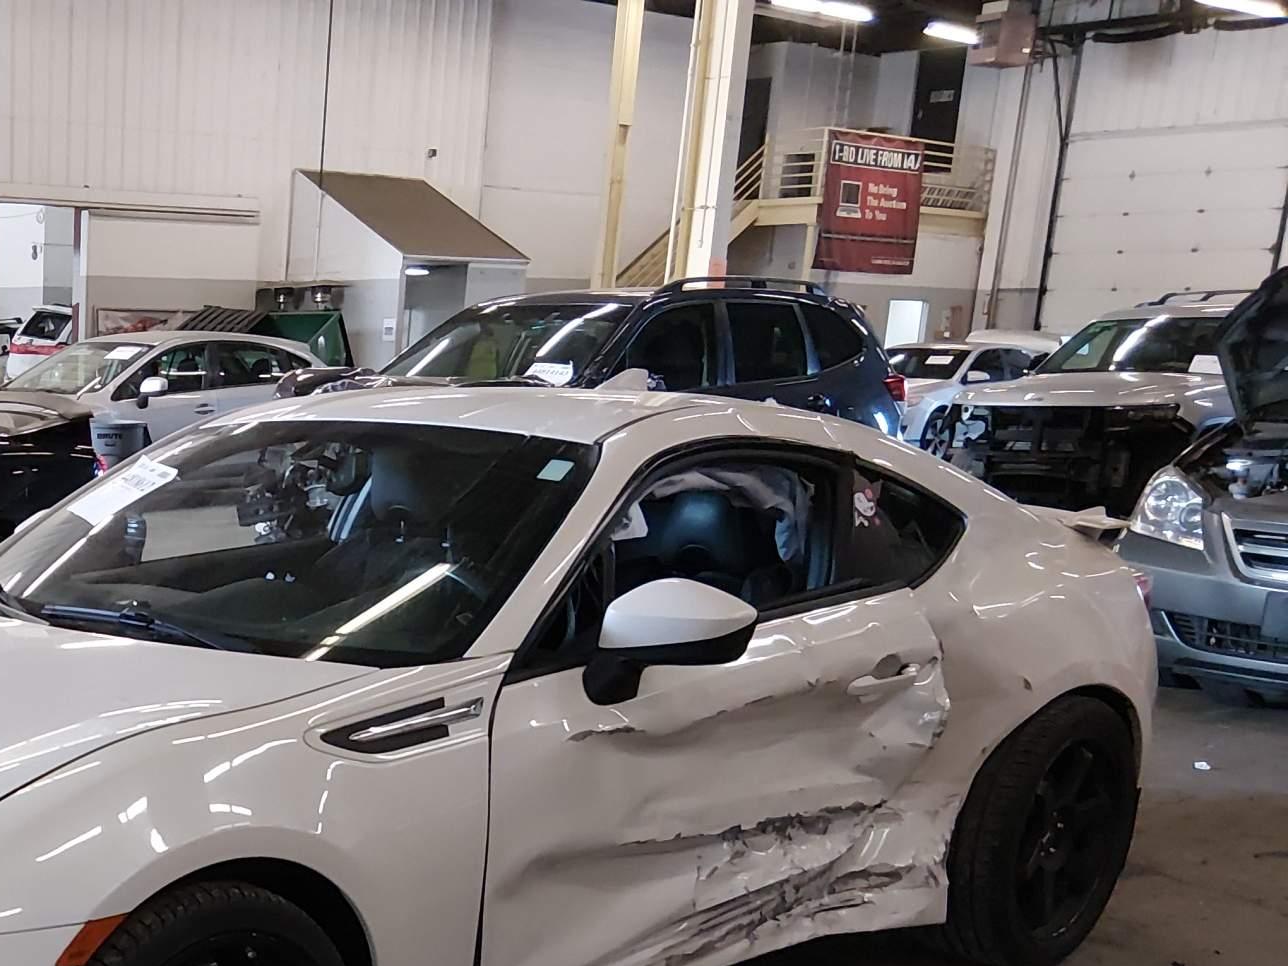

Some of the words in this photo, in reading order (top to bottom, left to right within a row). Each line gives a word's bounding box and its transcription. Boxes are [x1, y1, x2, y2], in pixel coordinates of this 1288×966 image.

[857, 148, 876, 165] LIVE
[877, 150, 902, 168] FROM
[880, 198, 907, 210] Auction
[865, 209, 873, 219] To
[875, 210, 887, 220] You
